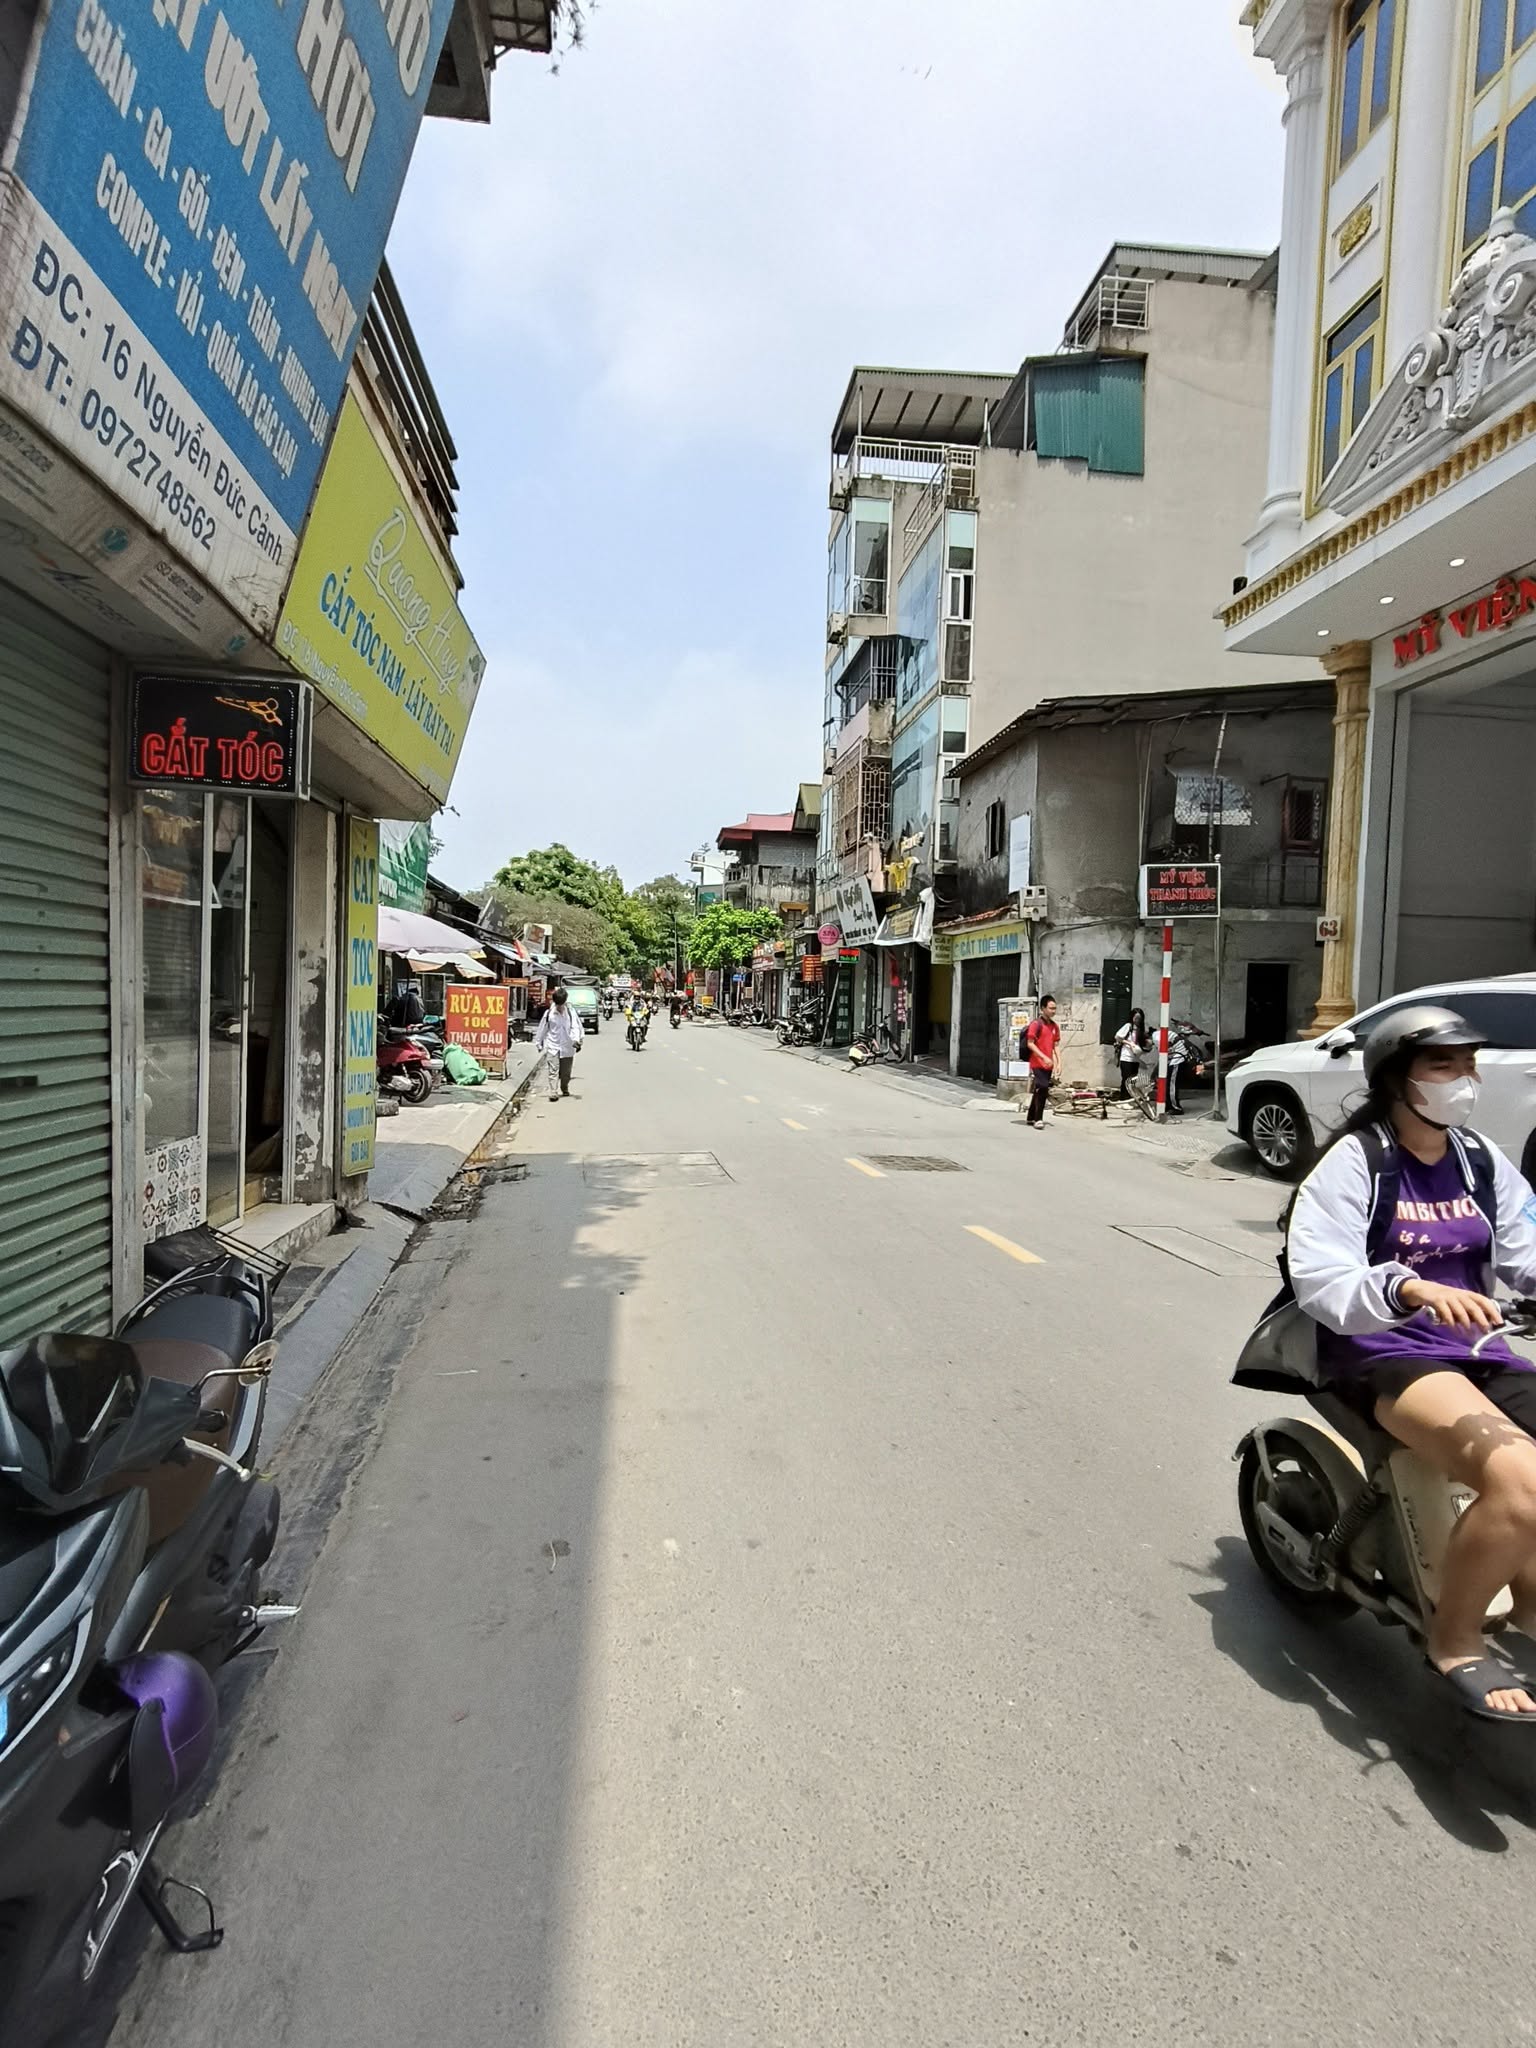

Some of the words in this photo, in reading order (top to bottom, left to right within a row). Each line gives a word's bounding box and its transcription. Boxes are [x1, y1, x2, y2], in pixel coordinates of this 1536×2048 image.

[144, 106, 173, 181] GA
[179, 166, 211, 240] GỐI
[212, 223, 246, 301] ĐỆM
[248, 283, 281, 363] THẢM
[259, 134, 313, 266] LẤY
[302, 228, 358, 362] NGAY
[96, 153, 172, 289] COMPLE
[176, 268, 204, 337] VẢI
[238, 363, 259, 418] ÁO
[254, 392, 278, 447] CÁC
[272, 421, 299, 481] LOẠI
[31, 240, 91, 338] ĐC:
[102, 322, 131, 381] 16
[134, 361, 211, 478] Nguyễn
[213, 460, 247, 519] Đức
[248, 504, 283, 566] Cảnh
[10, 316, 74, 406] ĐT:
[80, 388, 217, 550] 0972748562
[319, 564, 356, 636] CẮT
[351, 607, 381, 668] TÓC
[376, 641, 406, 697] NAM
[404, 676, 428, 722] LẤY
[1393, 609, 1443, 668] MỸ
[142, 716, 210, 777] CẮT
[217, 730, 285, 783] TÓC
[353, 828, 377, 905] CẮT
[1160, 868, 1176, 884] MỸ
[1179, 868, 1206, 887] VIỆN
[1149, 887, 1188, 901] THANH
[822, 929, 837, 938] SPA
[997, 931, 1019, 953] NAM
[1319, 919, 1338, 937] 63
[352, 923, 374, 987] TÓC
[449, 988, 482, 1014] RỬA
[485, 995, 505, 1015] XE
[462, 1016, 491, 1029] 10K
[349, 1010, 375, 1058] NAM
[449, 1031, 478, 1045] THAY
[1396, 1198, 1477, 1222] MBITIO
[1399, 1229, 1416, 1246] is
[1418, 1233, 1432, 1245] a
